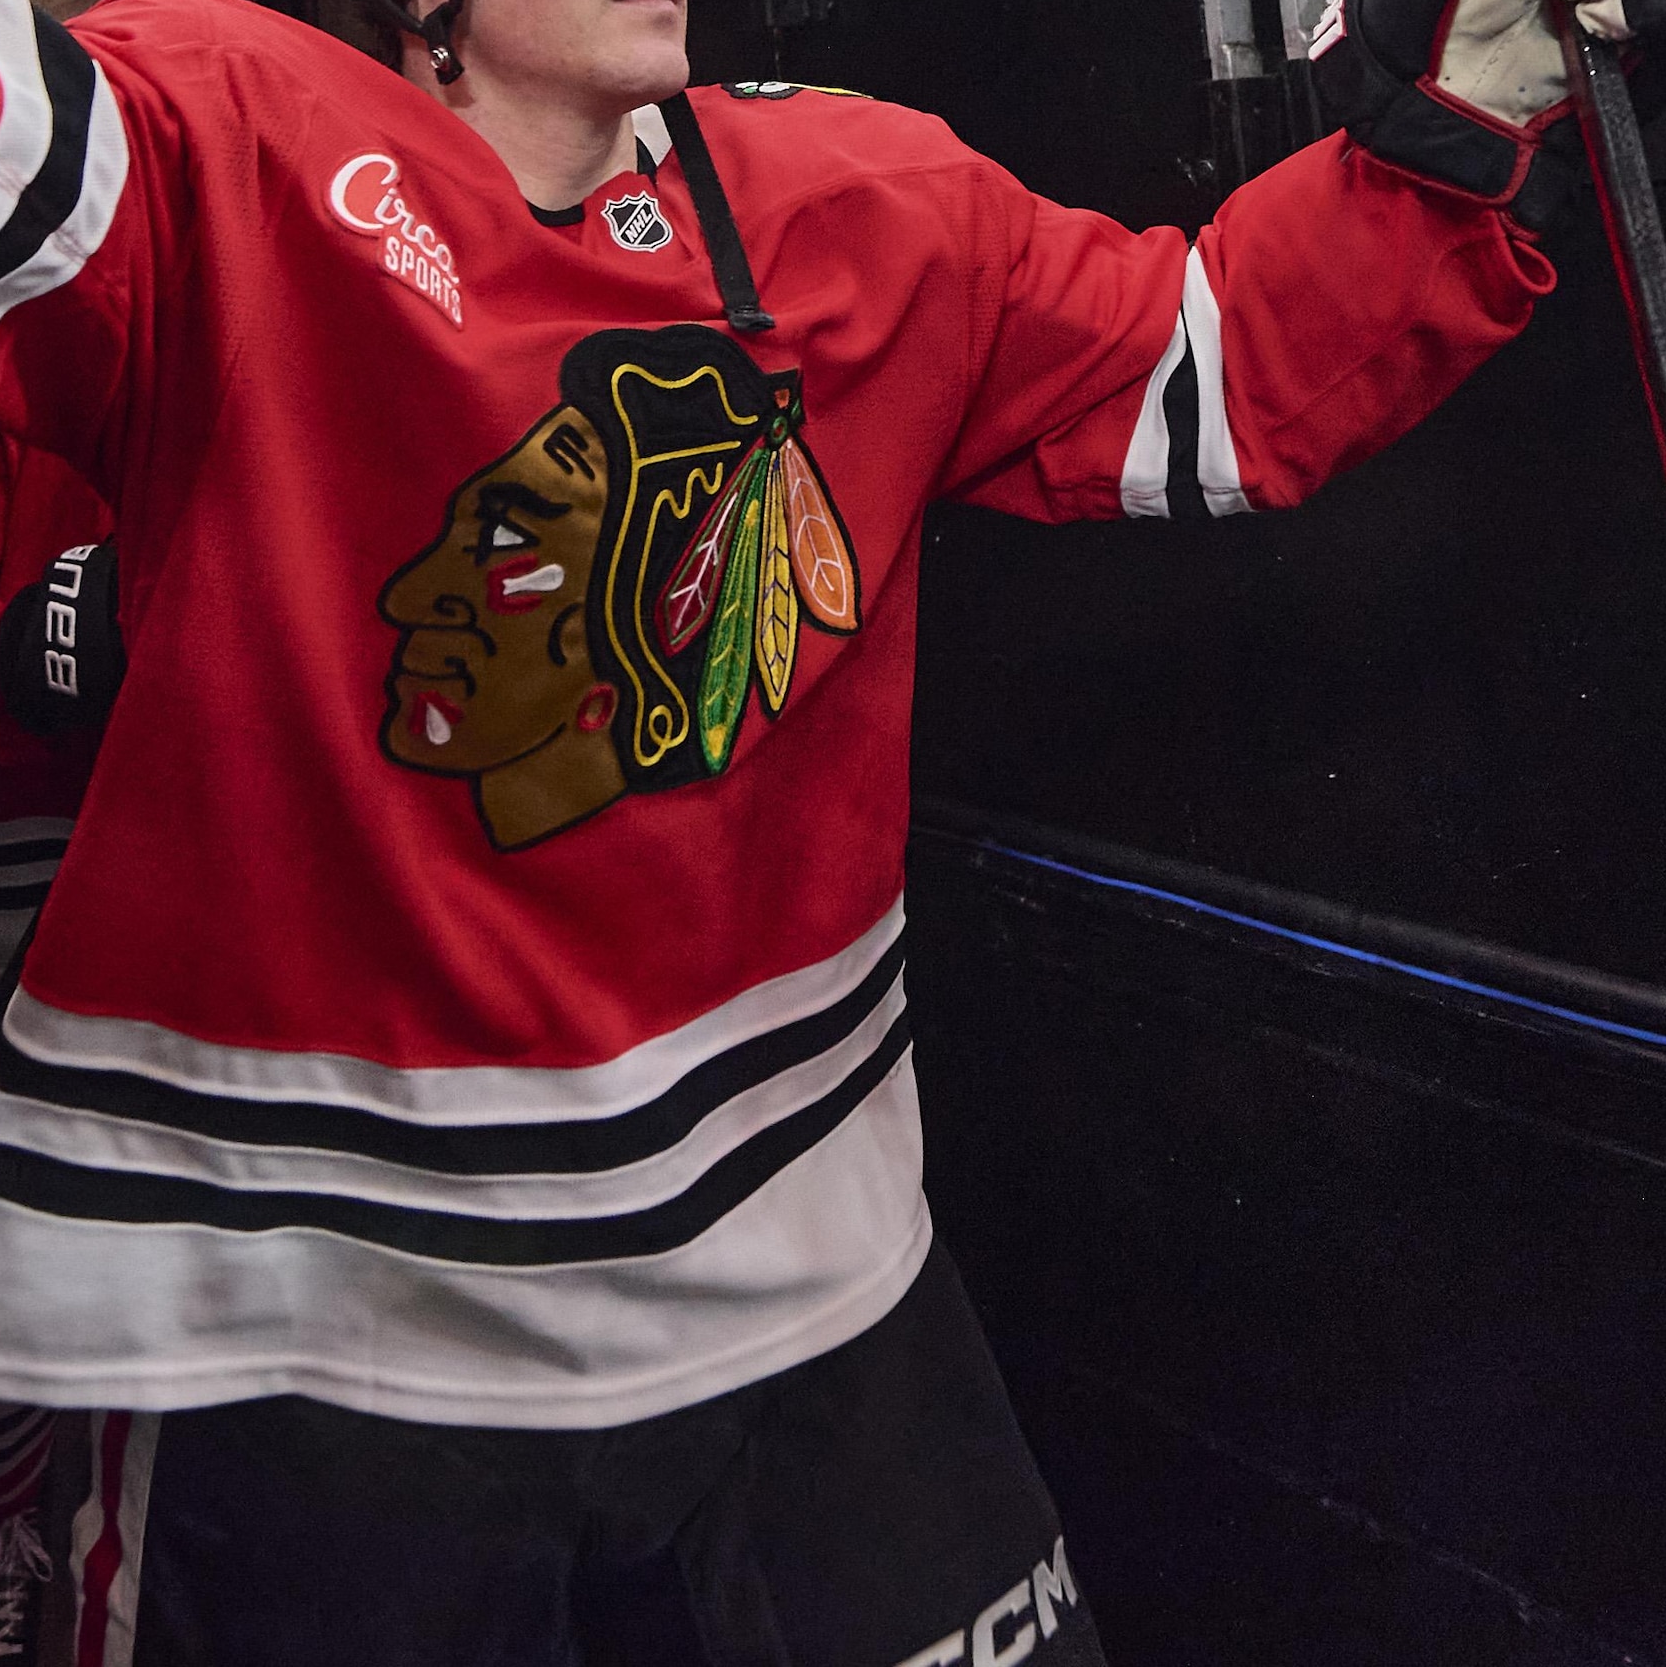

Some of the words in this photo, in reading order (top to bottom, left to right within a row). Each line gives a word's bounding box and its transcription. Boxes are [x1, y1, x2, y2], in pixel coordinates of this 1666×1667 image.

[330, 152, 460, 286] Circa
[623, 208, 653, 243] NHL
[383, 235, 464, 324] SPORTS
[891, 1534, 1079, 1667] CM
